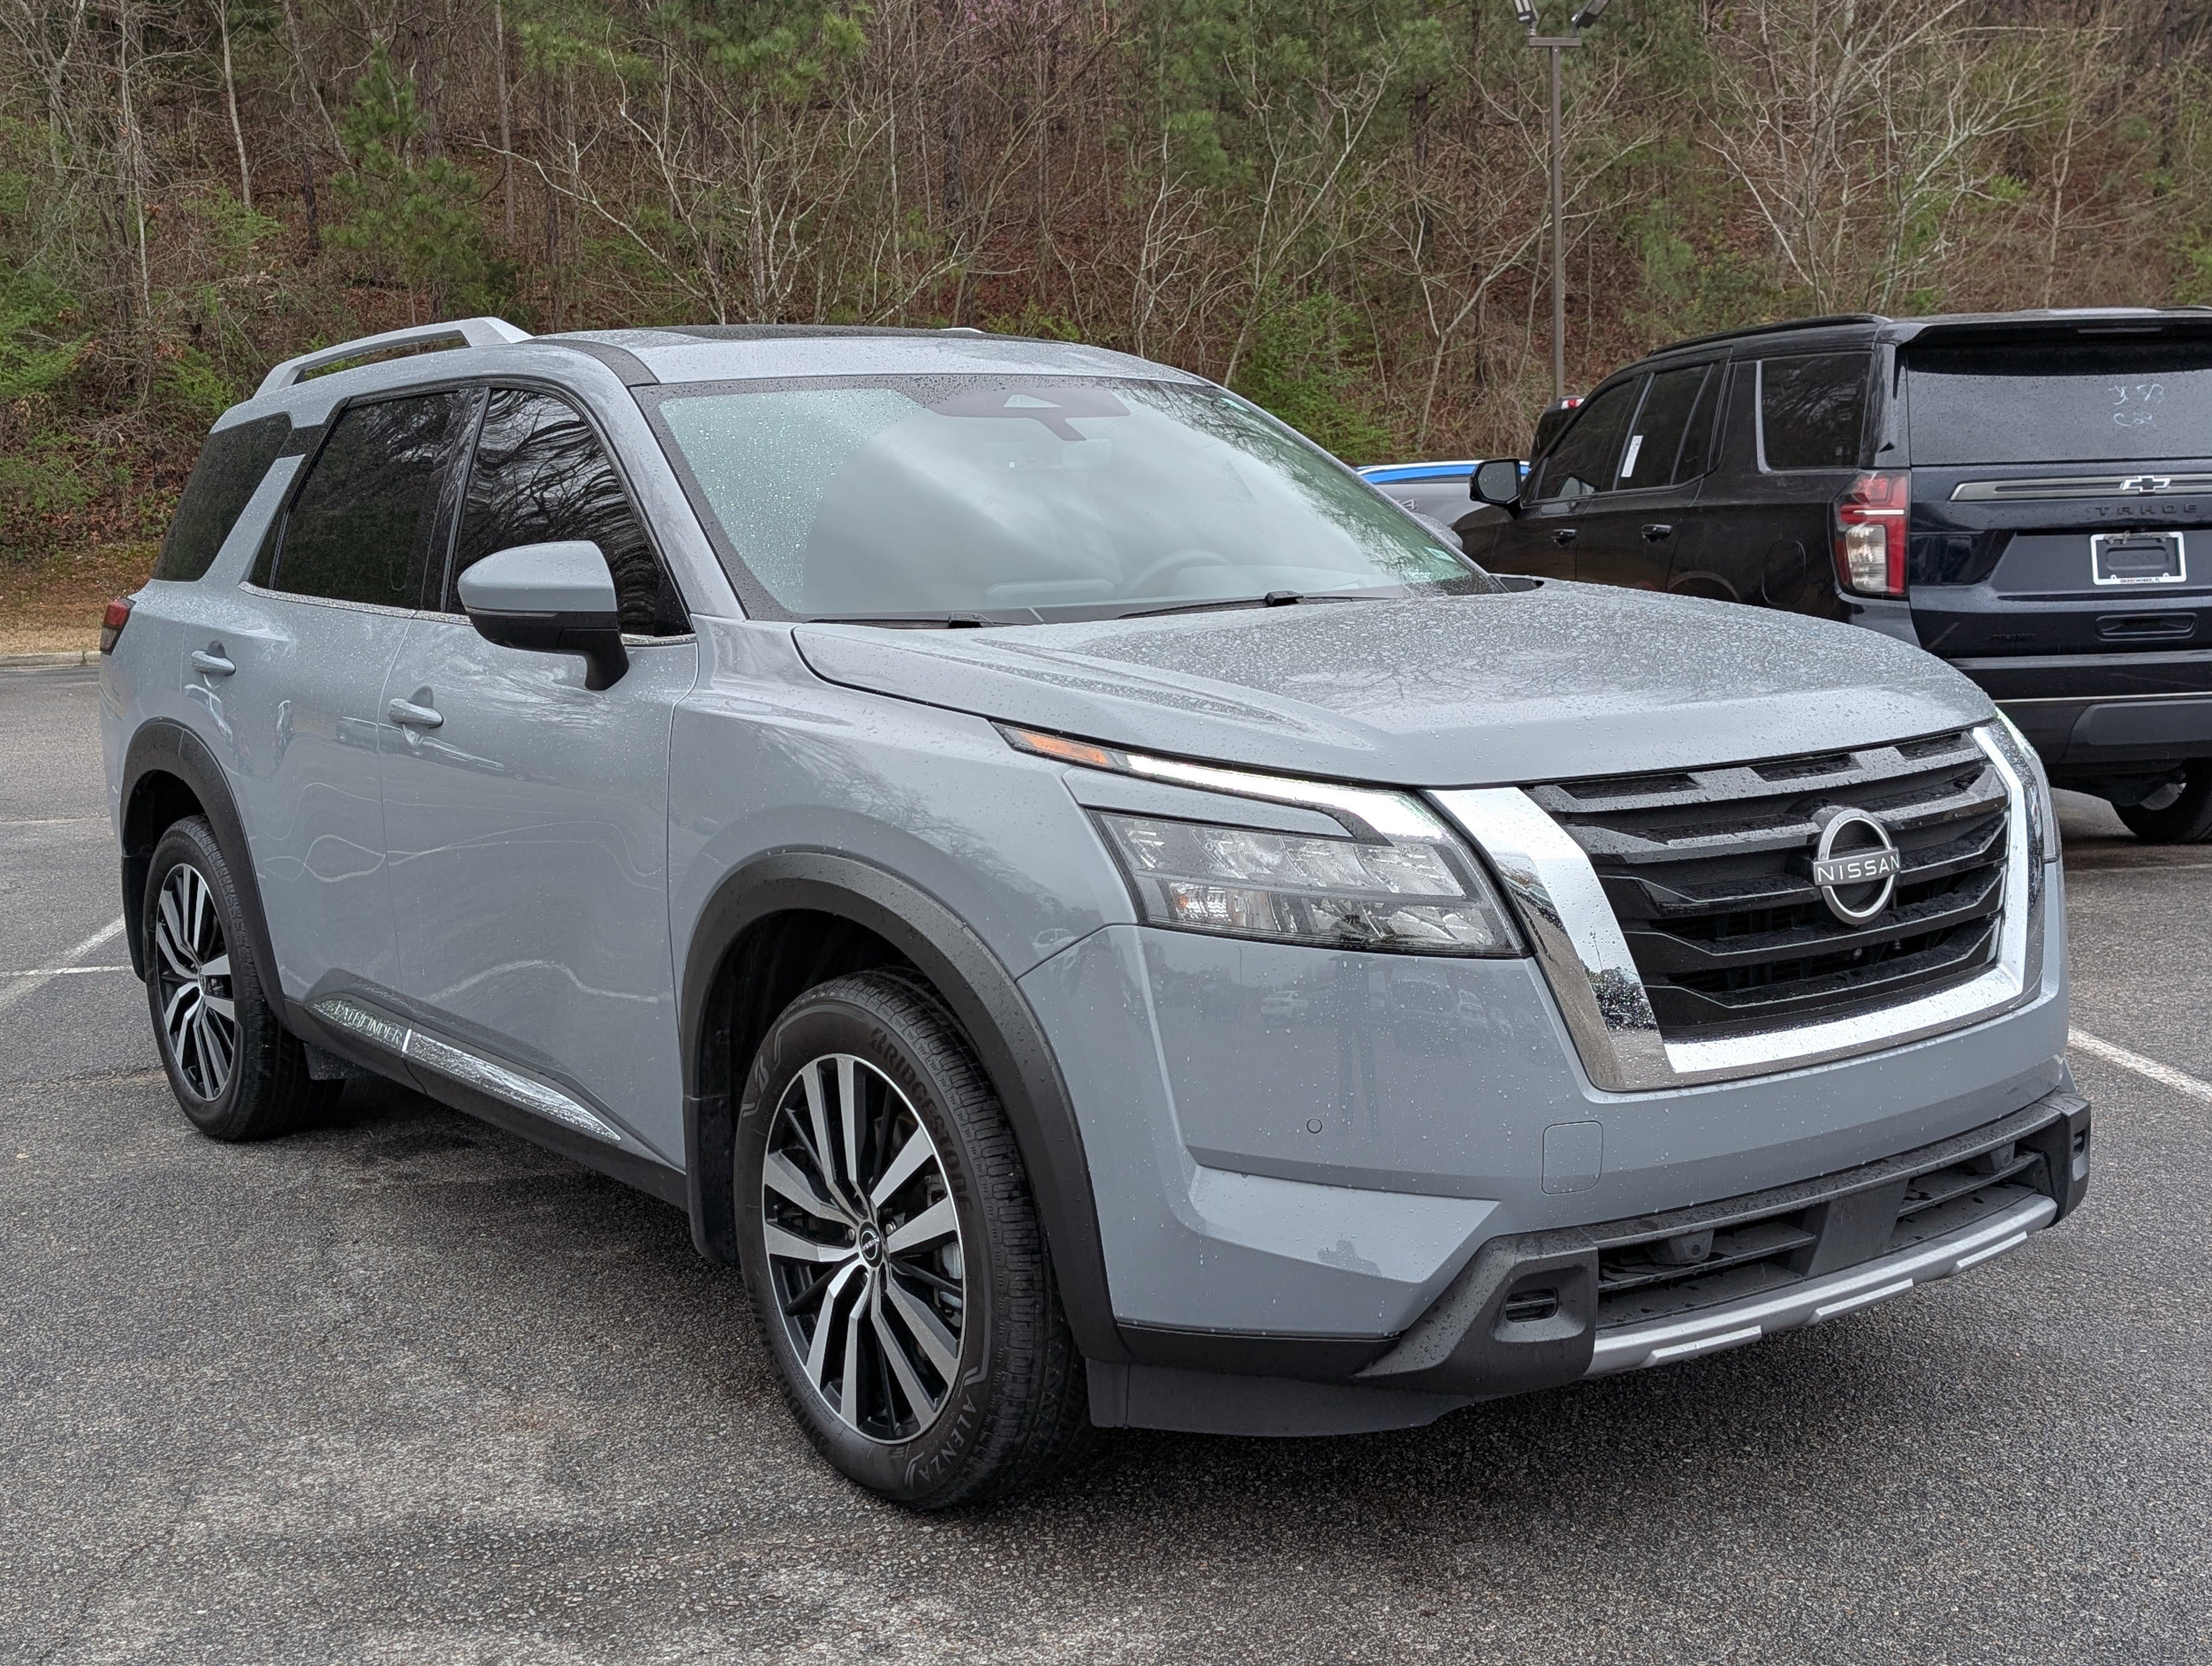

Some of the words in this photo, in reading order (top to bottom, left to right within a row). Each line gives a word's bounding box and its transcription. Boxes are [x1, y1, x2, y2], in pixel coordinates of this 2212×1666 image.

[2095, 503, 2197, 516] TAHOE
[1817, 853, 1900, 882] NISSAN
[869, 1026, 974, 1213] BRIDGESTONE
[918, 1393, 976, 1483] ALENZA
